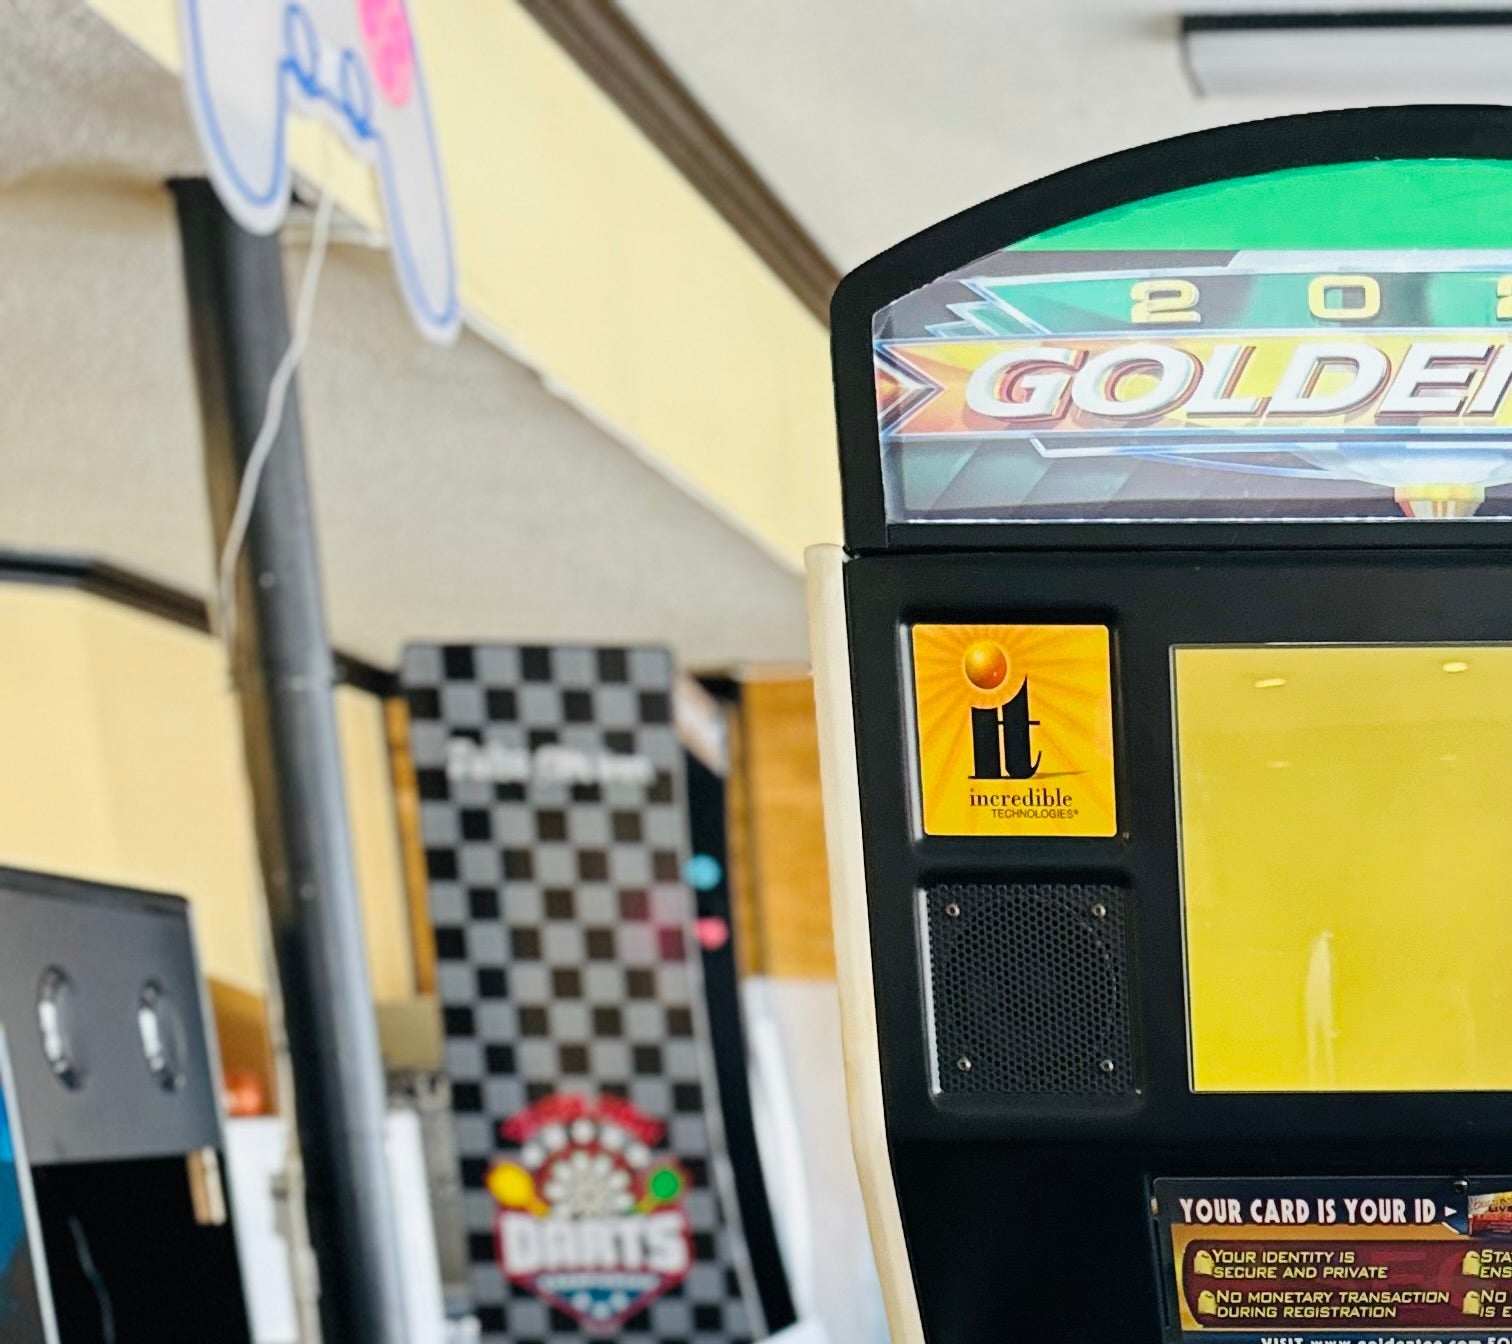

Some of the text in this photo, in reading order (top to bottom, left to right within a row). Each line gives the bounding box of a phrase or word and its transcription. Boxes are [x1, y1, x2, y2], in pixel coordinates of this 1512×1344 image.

[970, 788, 1072, 807] incredible
[1179, 1198, 1436, 1223] YOUR CARD IS YOUR ID
[1211, 1249, 1355, 1264] YOUR IDENTITY IS
[1213, 1266, 1388, 1279] SECURE AND PRIVATE
[1216, 1289, 1450, 1304] NO MONETARY TRANSACTION
[1480, 1289, 1506, 1303] NO
[1217, 1306, 1397, 1318] DURING REGISTRATION
[1480, 1306, 1496, 1318] IS
